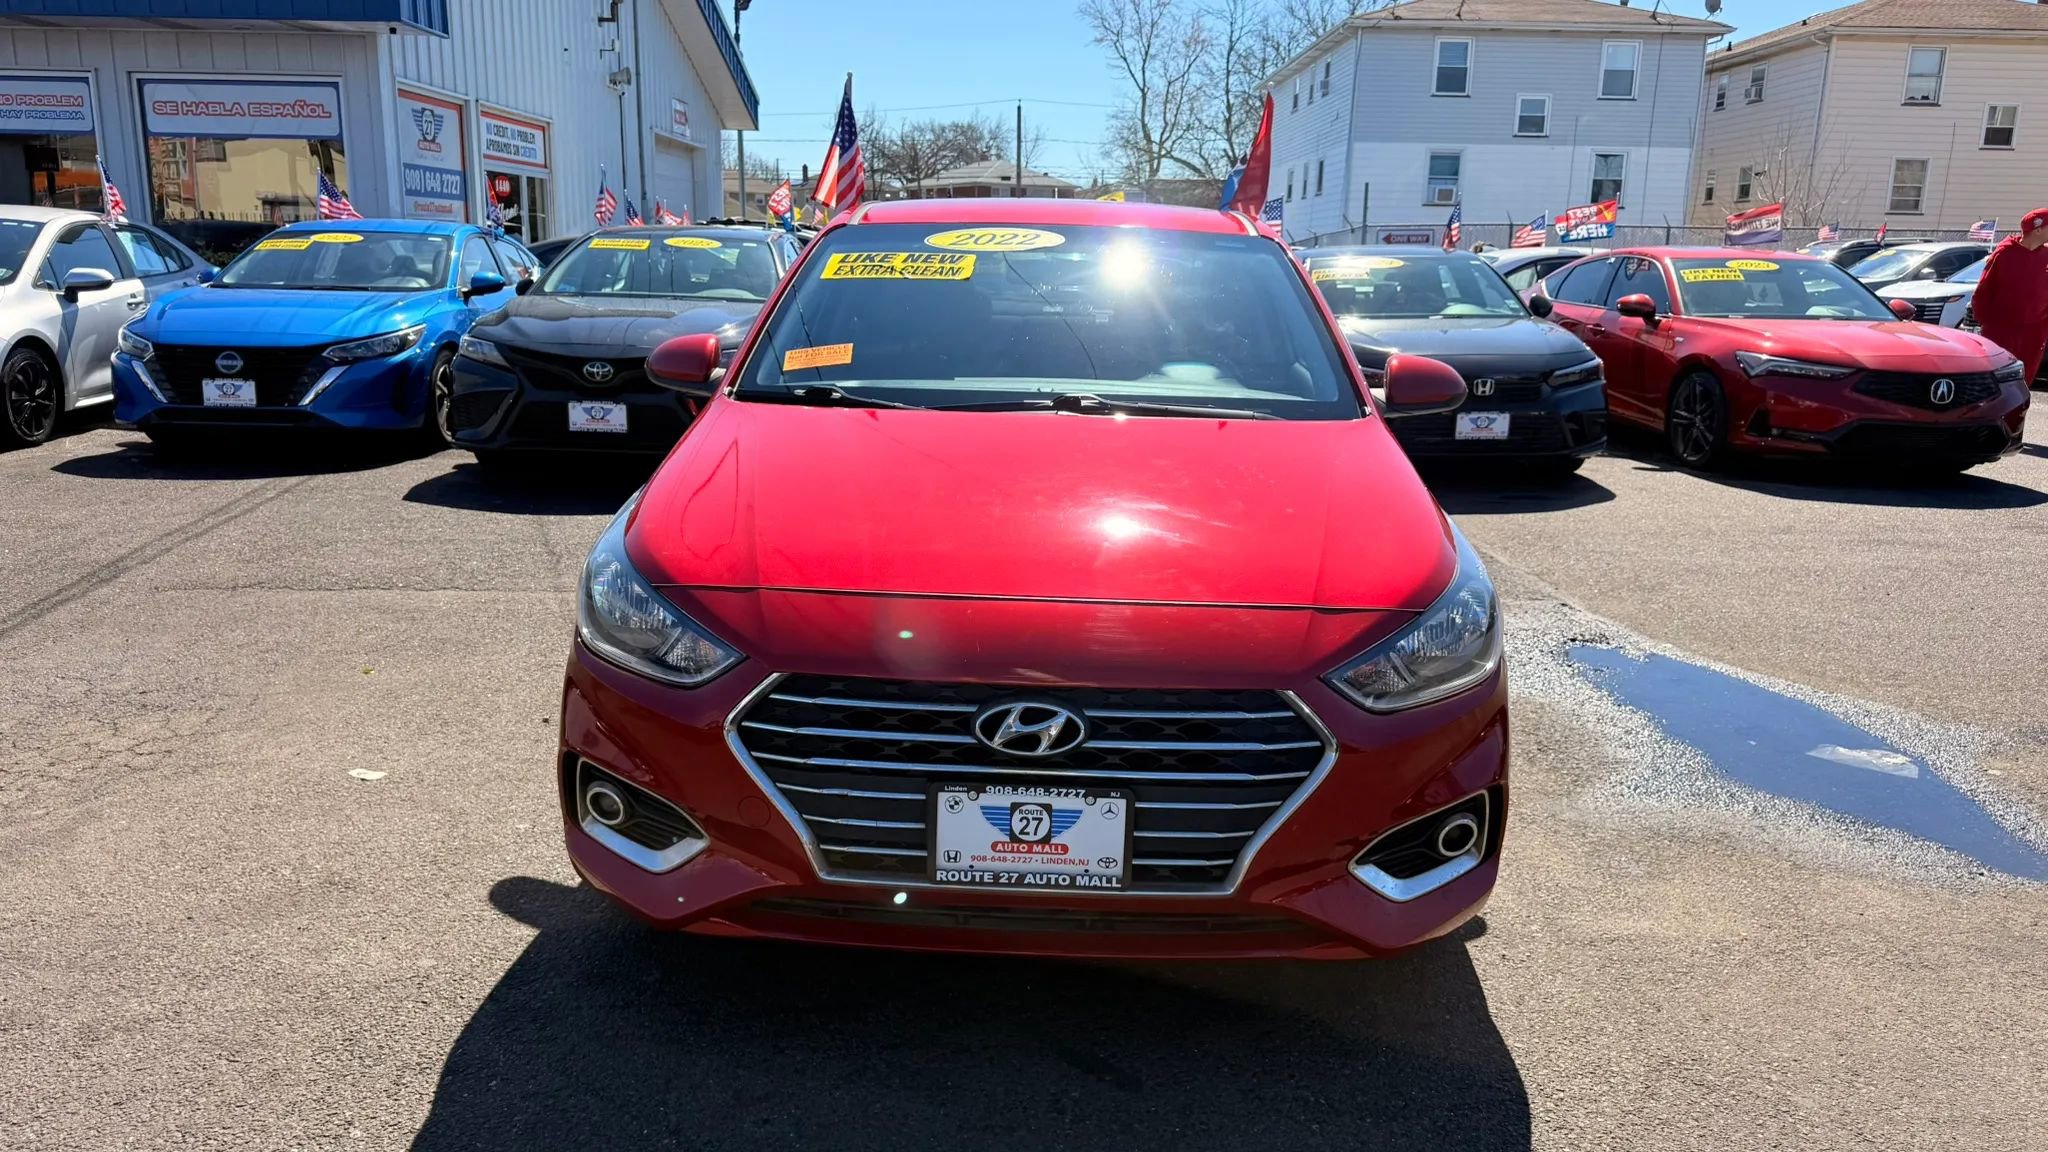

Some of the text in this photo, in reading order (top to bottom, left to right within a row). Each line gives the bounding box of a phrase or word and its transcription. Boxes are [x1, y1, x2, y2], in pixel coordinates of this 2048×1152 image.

[16, 95, 83, 107] PROBLEM
[25, 110, 84, 120] PROBLEMA
[153, 100, 331, 118] SE HABLA ESPAÑOL
[424, 119, 433, 136] 27
[517, 128, 536, 144] PROBLEM
[425, 171, 441, 193] 648
[442, 174, 460, 195] 2727
[948, 232, 1041, 246] 2022
[837, 253, 968, 265] LIKE NEW
[831, 264, 966, 277] EXTRA CLEAN
[985, 785, 1086, 799] 908-648-2727
[1018, 808, 1044, 816] ROUTE
[1018, 816, 1044, 836] 27
[995, 842, 1065, 854] AUTO MALL
[970, 854, 1090, 867] 908-648-2727 LINDEN,NJ
[936, 870, 1122, 888] ROUTE 27 AUTO MALL
